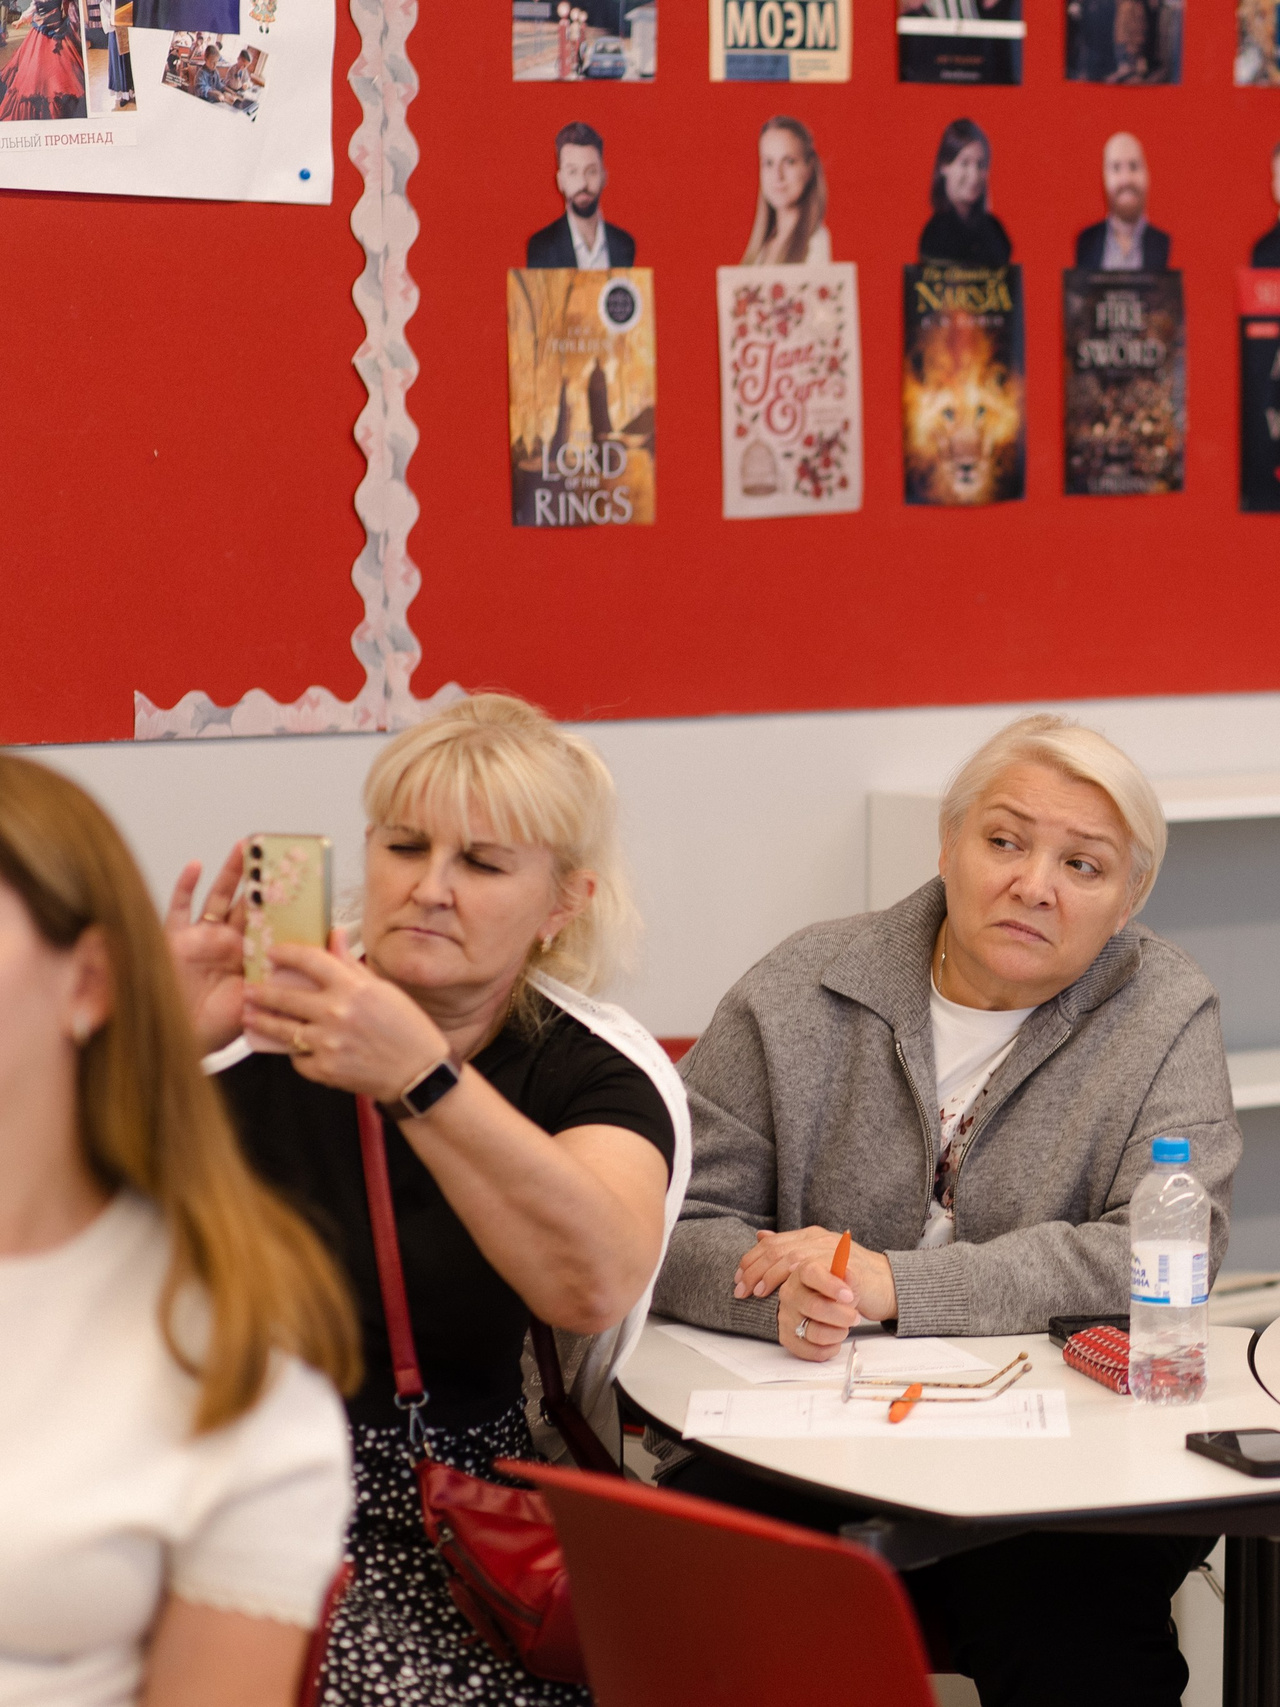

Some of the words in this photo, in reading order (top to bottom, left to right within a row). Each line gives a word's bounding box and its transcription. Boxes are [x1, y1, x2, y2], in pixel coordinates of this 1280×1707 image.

[726, 0, 837, 48] МОЭМ
[45, 131, 114, 146] ПРОМЕНАД
[542, 440, 628, 480] LORD
[535, 485, 633, 526] RINGS
